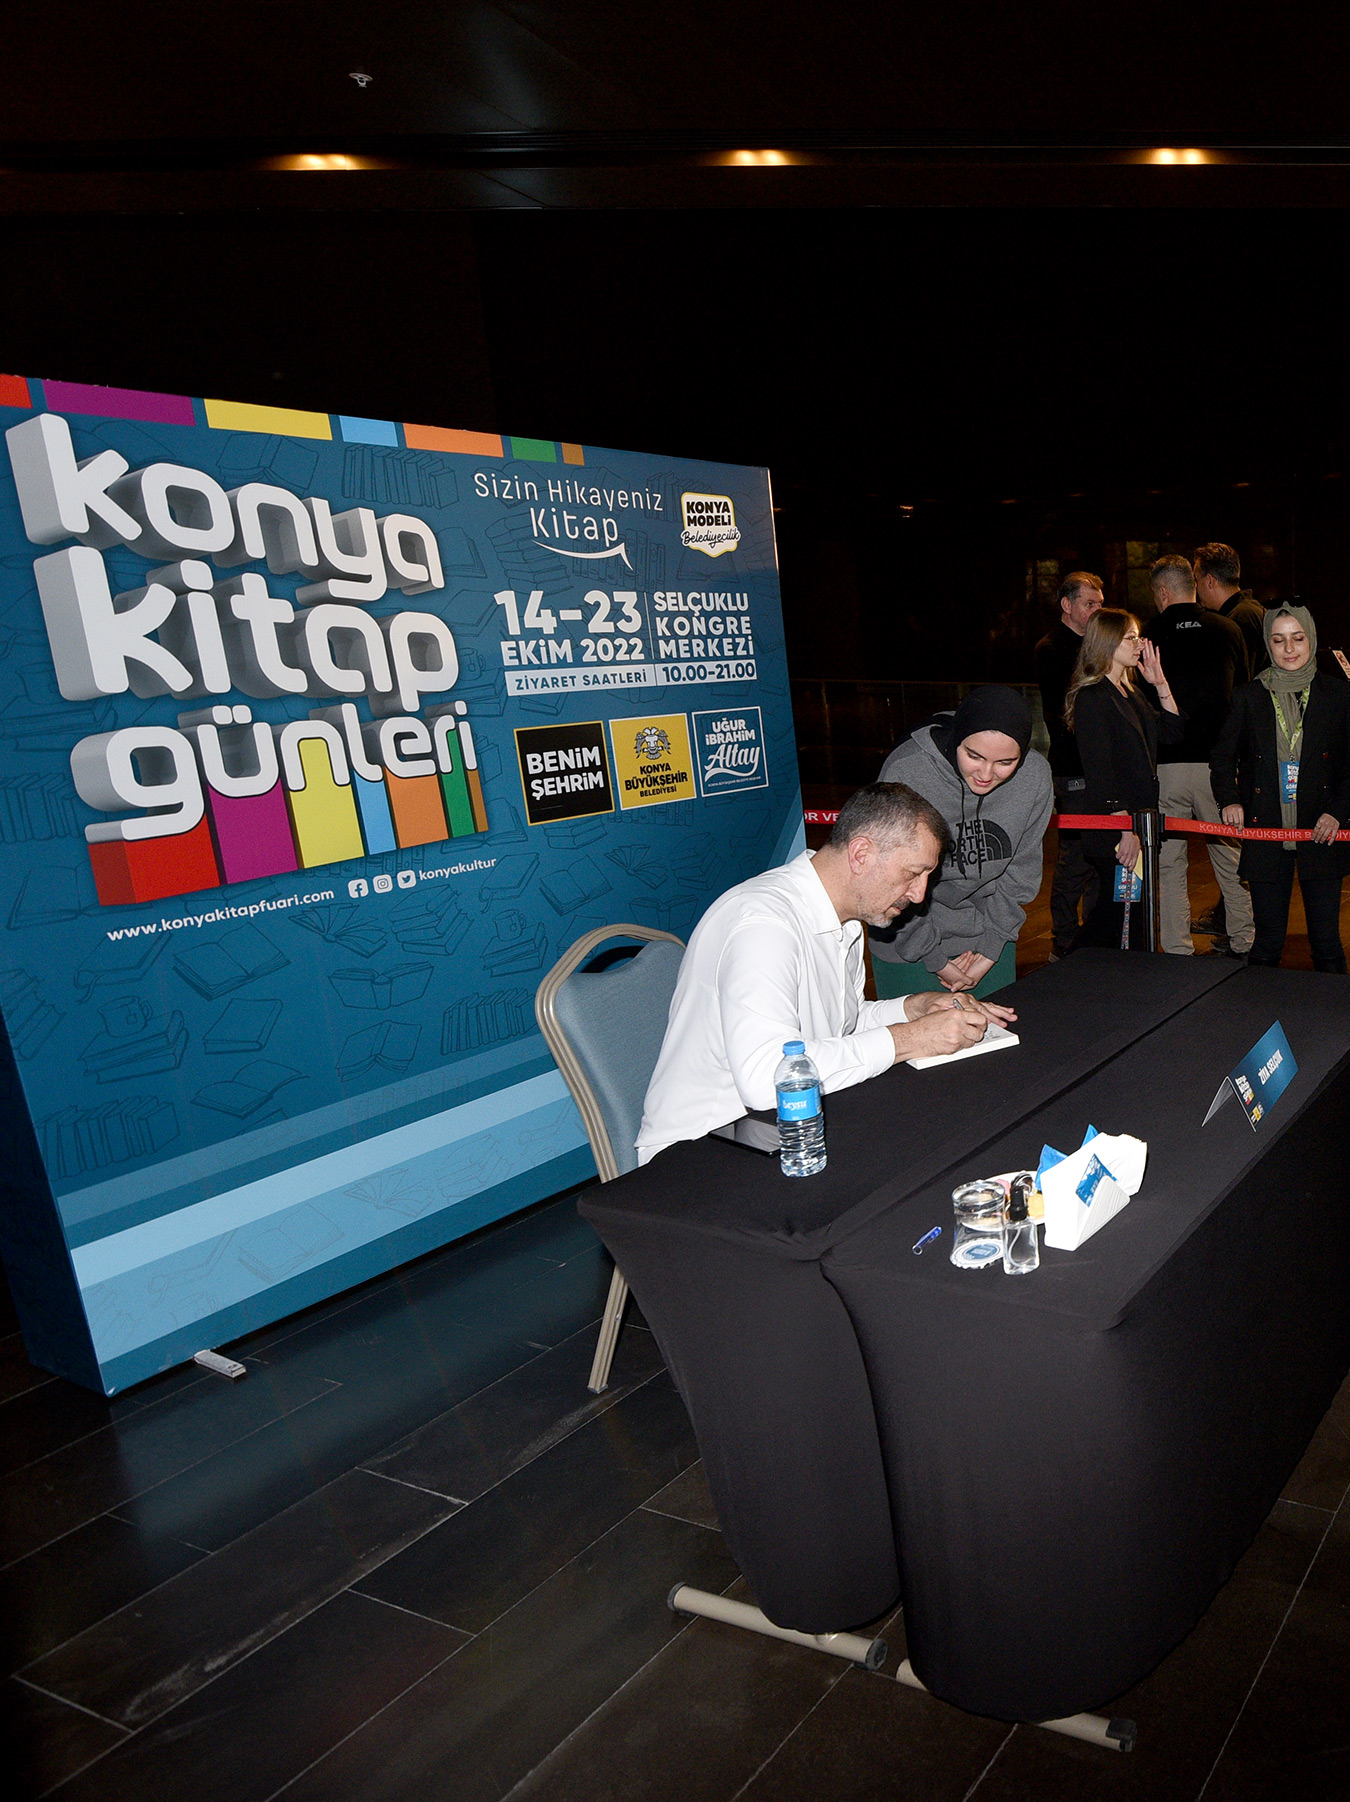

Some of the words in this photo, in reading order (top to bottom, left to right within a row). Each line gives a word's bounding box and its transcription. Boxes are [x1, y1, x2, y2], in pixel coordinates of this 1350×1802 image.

[474, 473, 538, 500] Sizin
[549, 480, 663, 511] Hikayeniz
[5, 413, 445, 602] konya
[686, 501, 730, 513] KONYA
[530, 507, 618, 547] Kitap
[687, 514, 731, 526] MODELİ
[682, 528, 739, 548] Belediyecilik
[653, 592, 749, 616] SELÇUKLU
[33, 546, 459, 712] kitap
[655, 616, 752, 637] KONGRE
[501, 639, 573, 666] EKİM
[580, 638, 645, 662] 2022
[659, 636, 754, 659] MERKEZİ
[515, 674, 577, 691] ZİYARET
[583, 669, 647, 686] SAATLERİ
[662, 662, 756, 682] 10.00-21.00
[712, 718, 746, 733] UĞUR
[705, 729, 756, 745] İBRAHİM
[526, 746, 601, 774] BENİM
[639, 763, 671, 775] KONYA
[704, 744, 760, 783] Altay
[70, 701, 478, 842] günleri
[624, 770, 688, 791] BÜYÜKŞEHİR
[530, 771, 604, 800] ŞEHRİM
[640, 786, 677, 798] BELEDİYESİ
[955, 819, 983, 836] THE
[1199, 823, 1235, 836] KONYA
[947, 833, 985, 854] ORTH
[951, 848, 987, 867] FACE
[419, 856, 498, 882] konyakultur
[107, 888, 334, 941] www.konyakitapfuari.com
